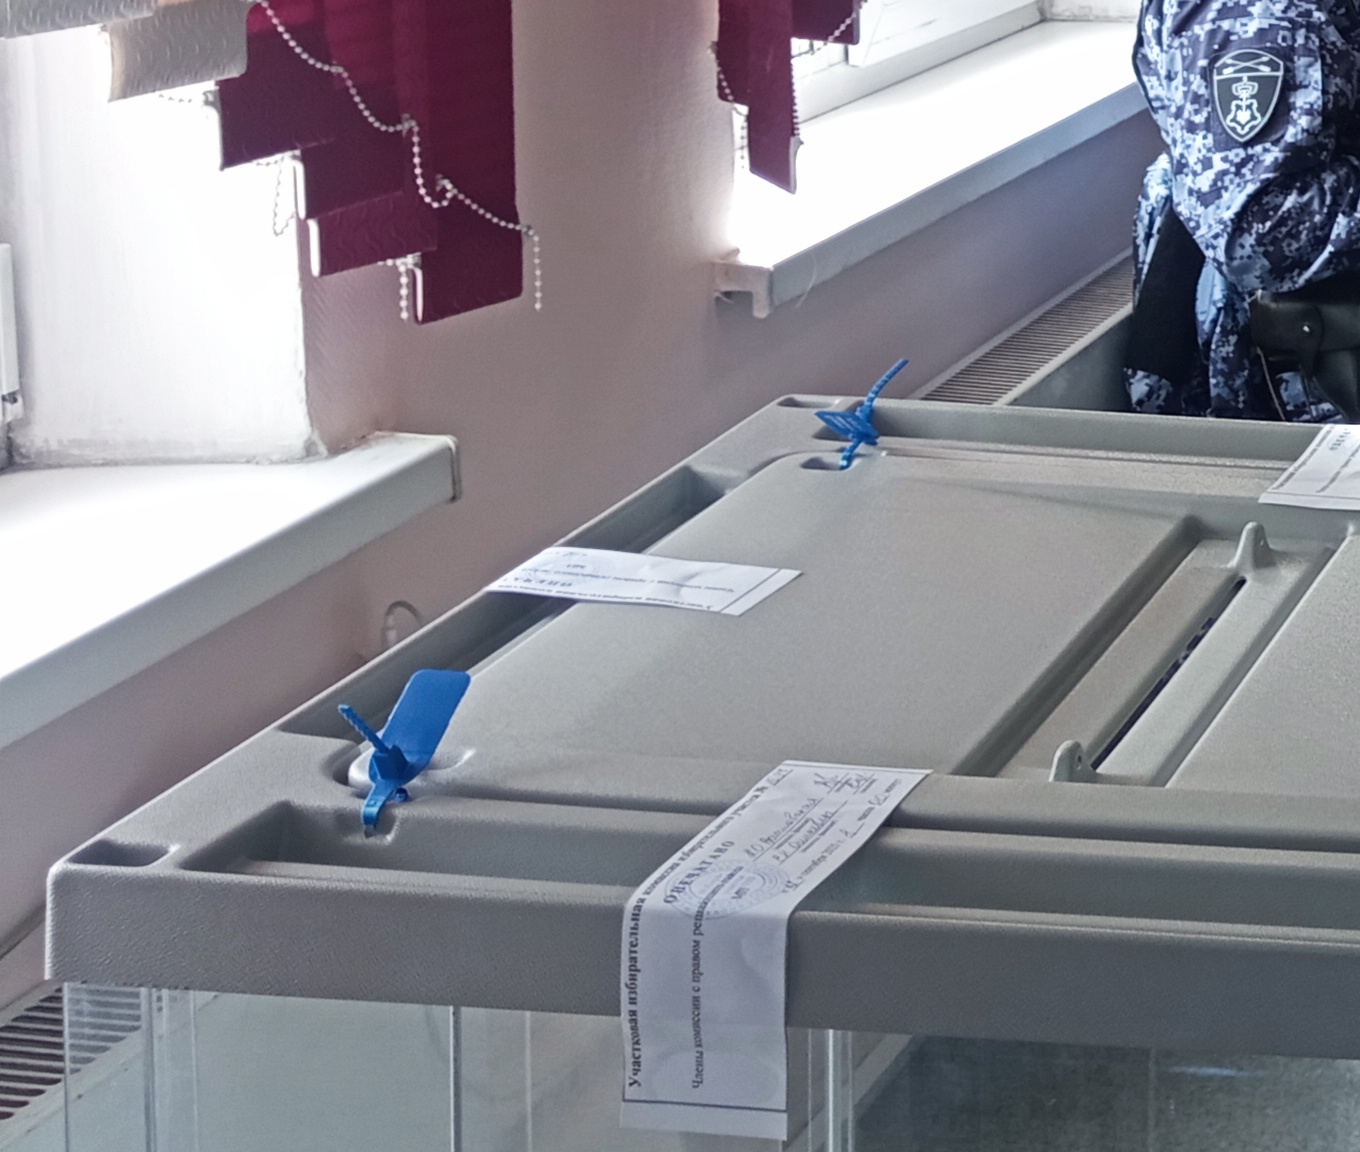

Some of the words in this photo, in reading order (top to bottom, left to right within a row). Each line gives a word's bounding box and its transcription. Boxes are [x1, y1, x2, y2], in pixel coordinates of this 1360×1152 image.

[625, 898, 646, 1006] избирательная
[692, 939, 704, 984] правом
[692, 985, 701, 993] с
[692, 996, 704, 1048] комиссии
[628, 1009, 642, 1088] Участковая
[691, 1050, 704, 1089] Члены
